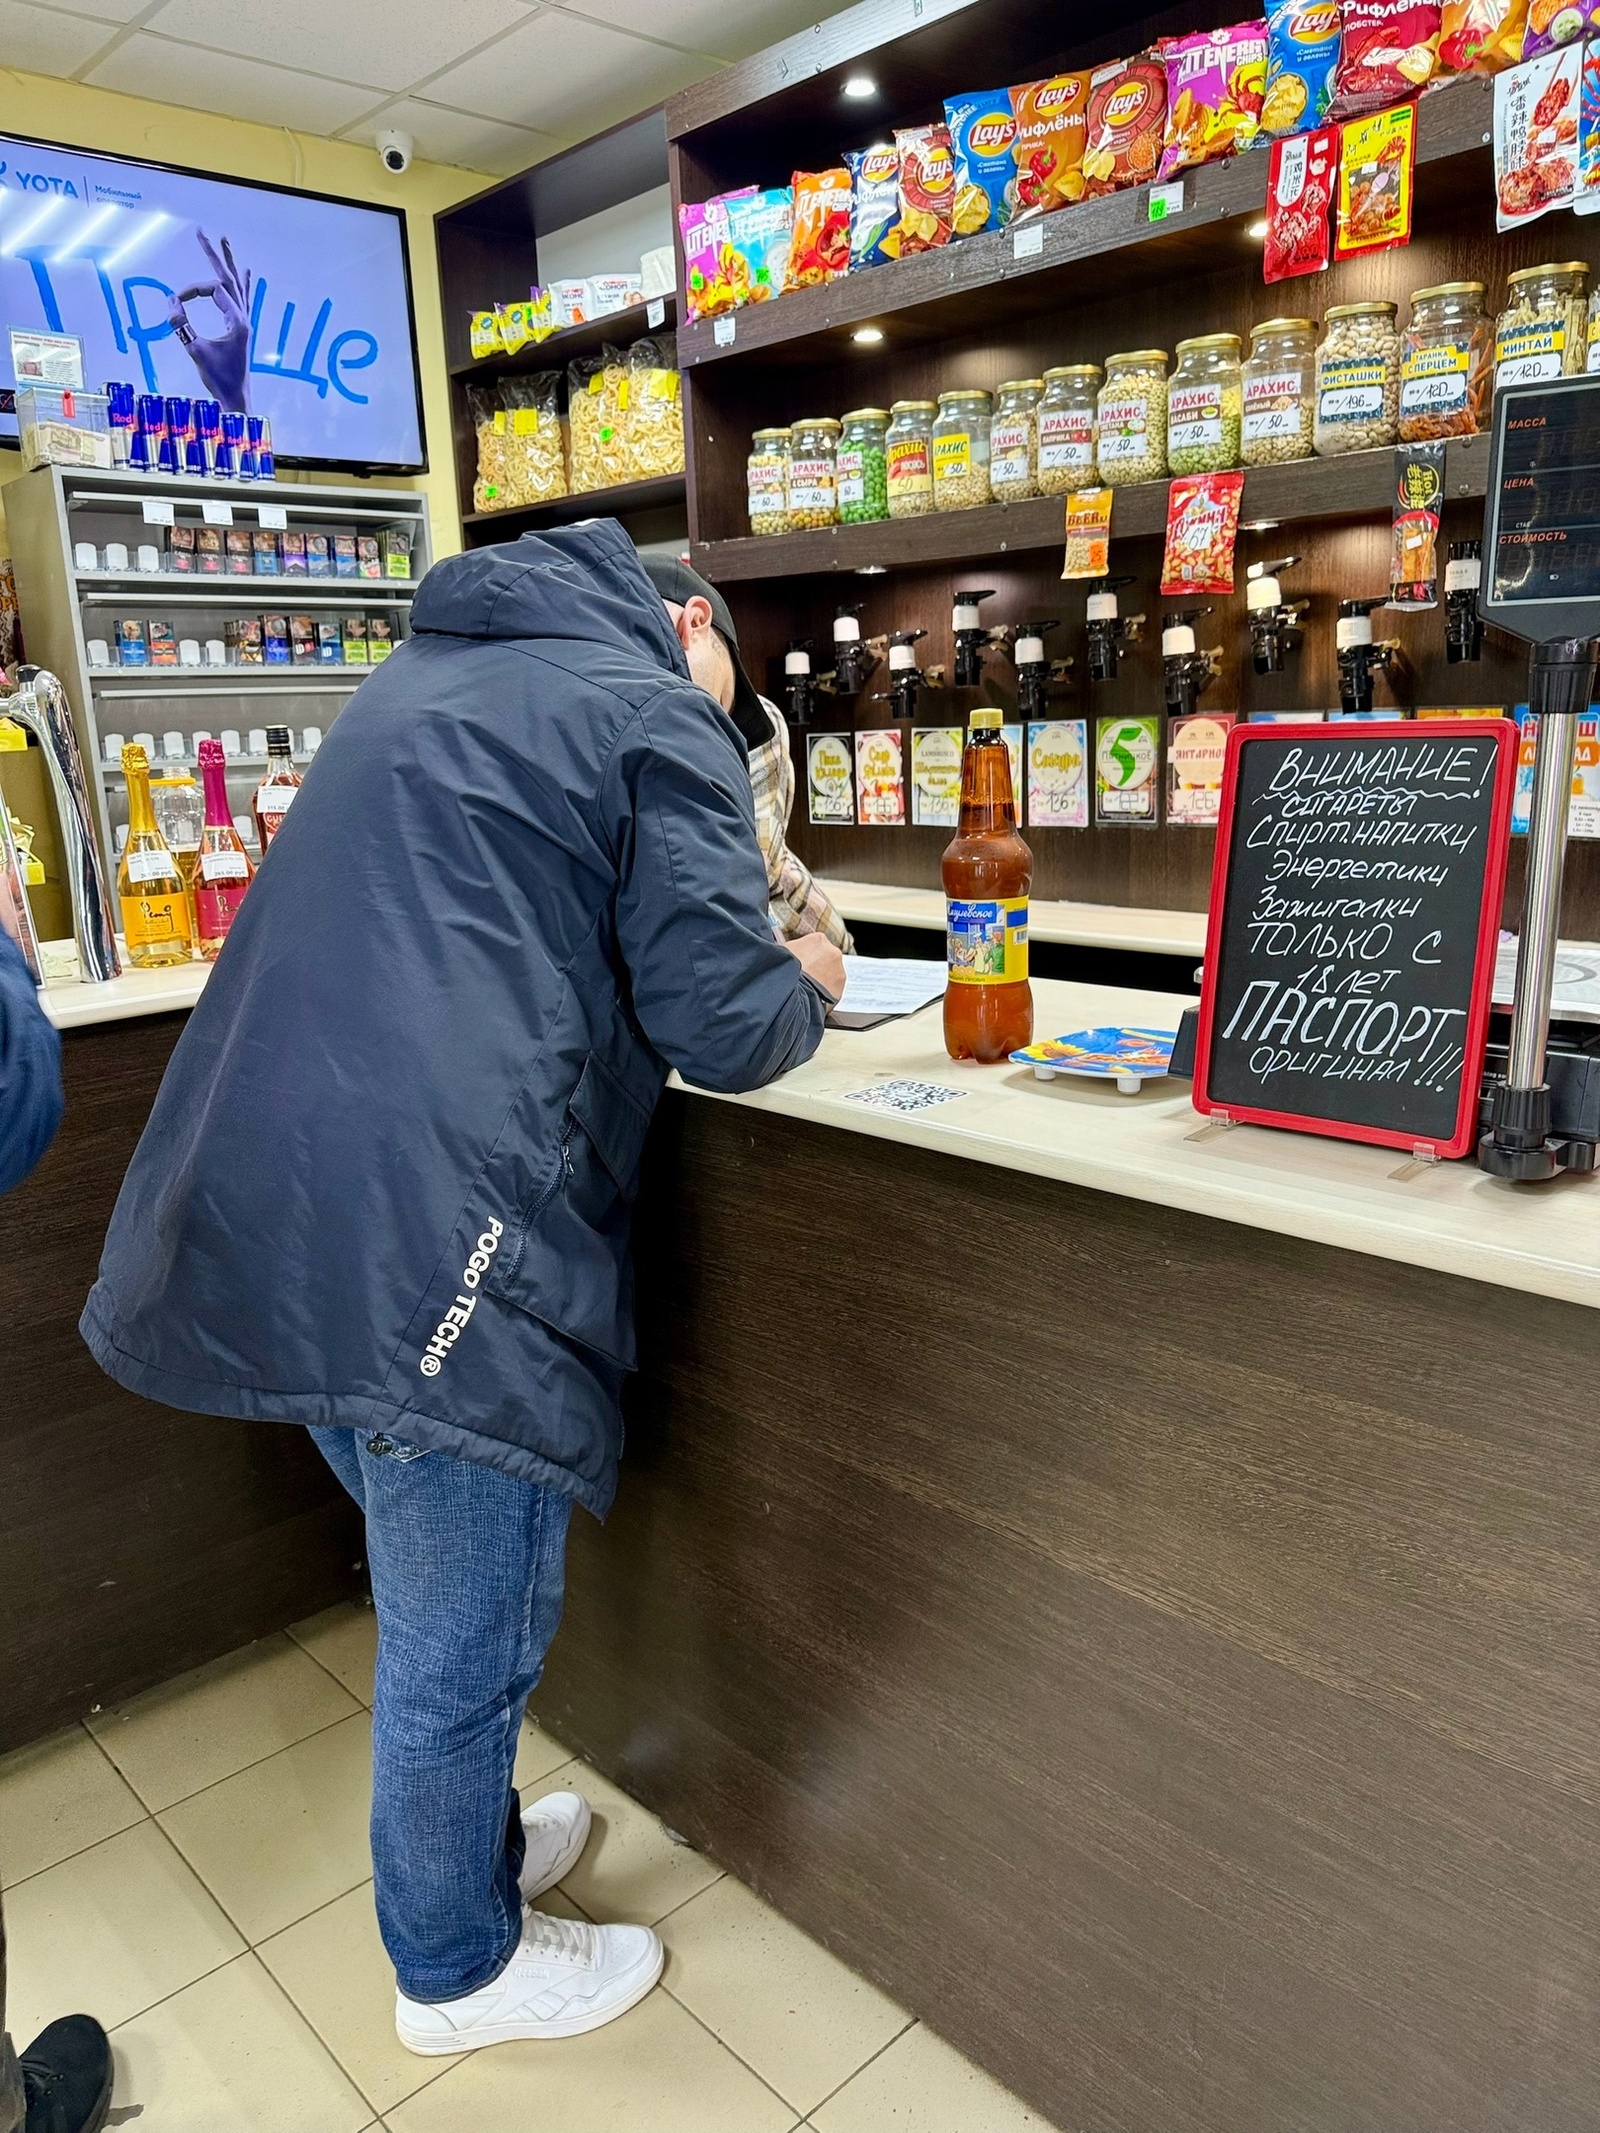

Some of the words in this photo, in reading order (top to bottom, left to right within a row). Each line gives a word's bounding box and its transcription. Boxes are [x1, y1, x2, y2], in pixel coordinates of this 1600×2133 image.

[1236, 52, 1263, 66] CHIPS
[1036, 82, 1079, 108] Lay's
[1105, 89, 1145, 117] Lay's
[971, 120, 1015, 147] Lay's
[15, 170, 79, 199] YOTA
[95, 185, 142, 200] Мобильный
[1502, 336, 1553, 356] МИНТАЙ
[1415, 350, 1449, 361] ТАРАНКА
[1414, 358, 1457, 373] ПЕРЦЕМ
[1322, 370, 1382, 386] ФИСТАШКИ
[1246, 380, 1296, 399] АРАХИС
[1171, 391, 1215, 410] АРАХИС
[1100, 405, 1142, 423] АРАХИС
[1267, 413, 1284, 430] 50
[1043, 416, 1088, 431] АРАХИС
[1507, 416, 1547, 430] МАССА
[992, 432, 1024, 447] РАХИС
[1189, 424, 1205, 440] 50
[1115, 437, 1131, 453] 50
[1062, 446, 1077, 461] 50
[749, 468, 778, 480] РАХИС
[793, 463, 831, 475] АРАХИС
[1422, 469, 1434, 495] Hot
[1503, 477, 1535, 490] ЦЕНА
[1499, 530, 1568, 545] СТОИМОСТЬ
[1175, 749, 1225, 760] ЯНТАРНО
[1265, 850, 1449, 890] Энергетики
[1252, 885, 1423, 921] Зажигалки
[1247, 922, 1394, 960] ТОЛЬКО
[1294, 963, 1336, 993] 18
[1222, 980, 1467, 1063] ПАСПОРТ
[463, 1215, 504, 1290] POGO
